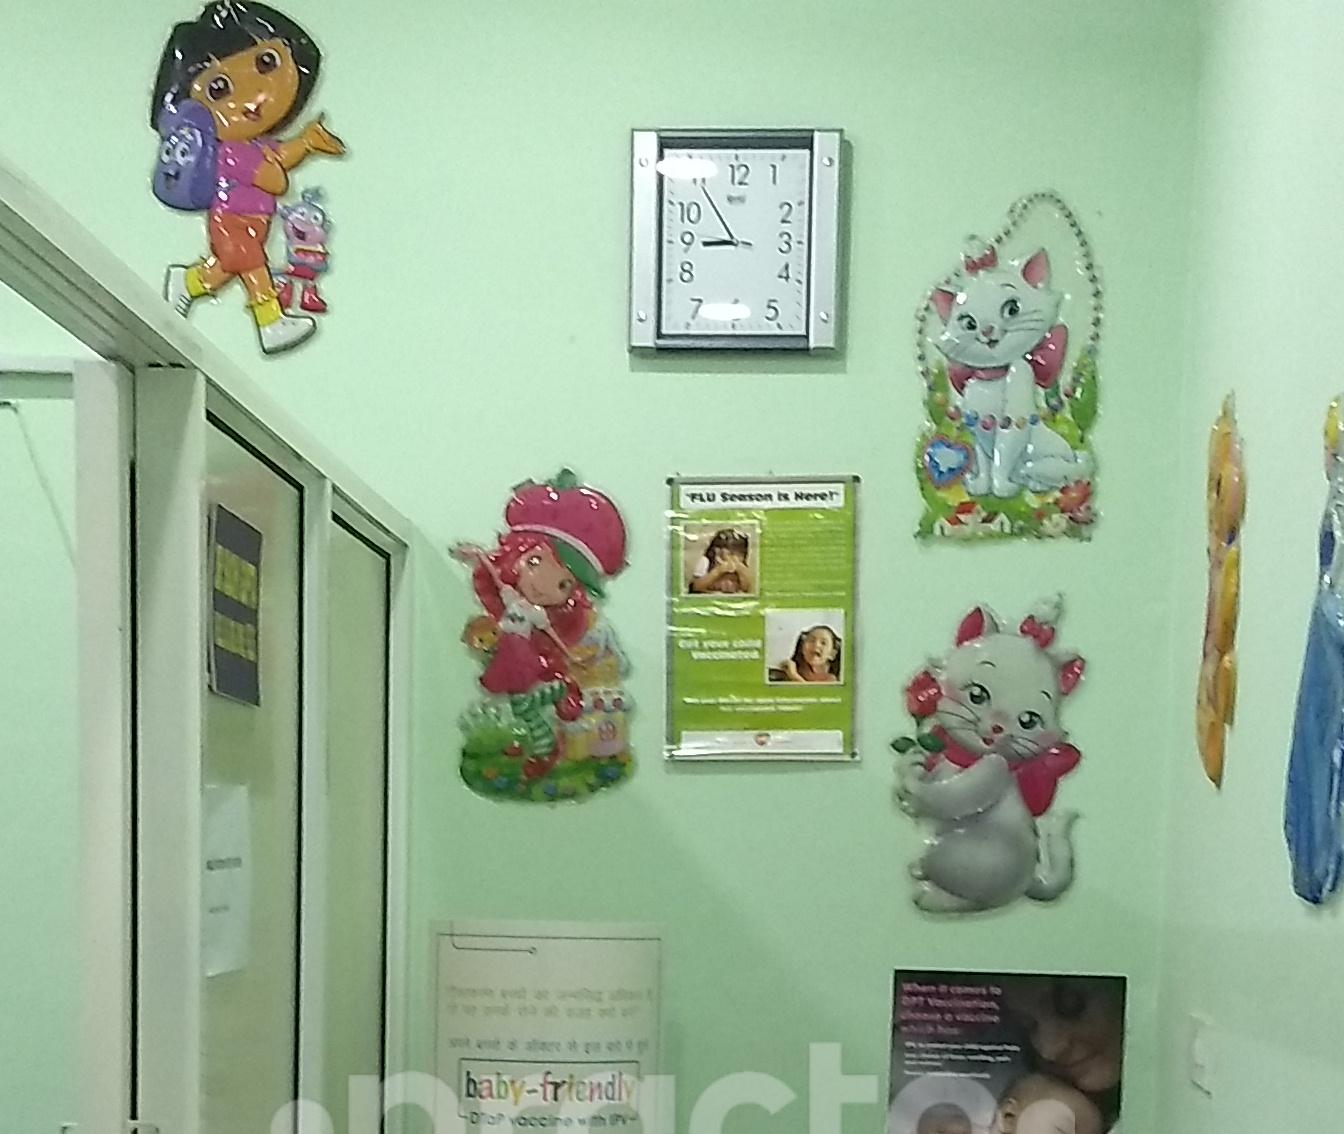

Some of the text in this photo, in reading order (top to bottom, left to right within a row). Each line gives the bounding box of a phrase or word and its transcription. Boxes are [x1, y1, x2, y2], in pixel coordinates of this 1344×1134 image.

[728, 163, 778, 186] 12 1
[678, 201, 794, 225] 10 2
[680, 230, 793, 255] 9 3
[679, 260, 791, 284] 8 4
[689, 297, 780, 322] 7 5
[465, 1069, 635, 1106] baby-friendly
